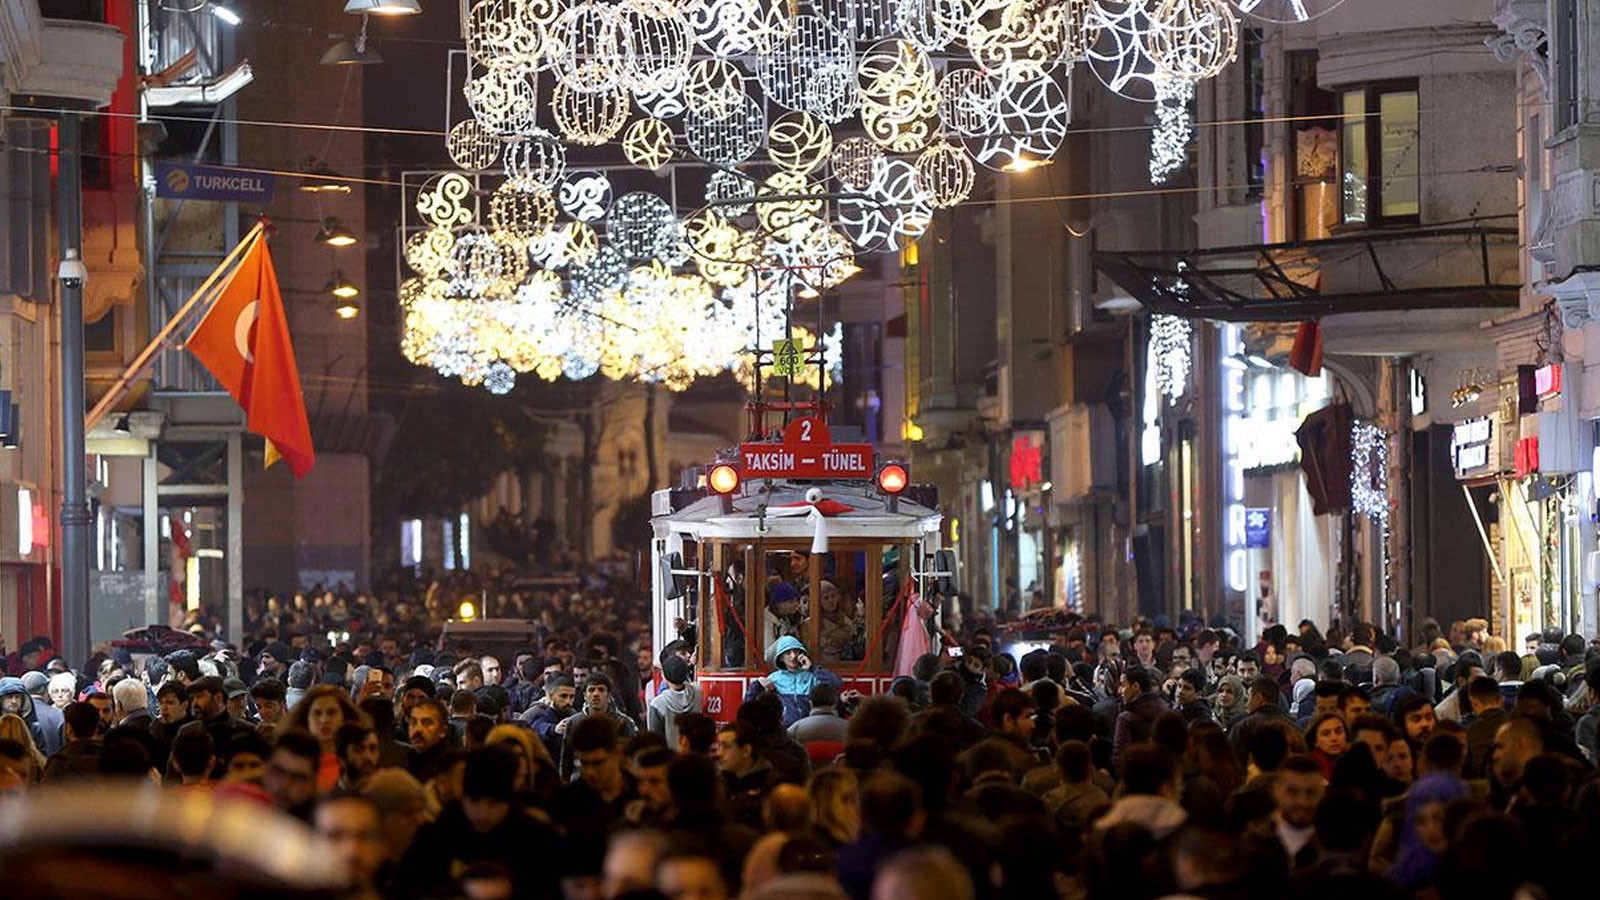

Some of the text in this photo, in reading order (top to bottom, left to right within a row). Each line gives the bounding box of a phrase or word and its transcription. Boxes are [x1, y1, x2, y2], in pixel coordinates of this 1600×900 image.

[194, 175, 265, 192] TURKCELL
[780, 355, 799, 366] 600
[778, 366, 801, 374] VOT
[801, 420, 812, 442] 2
[745, 449, 795, 471] TAKSİM
[822, 449, 866, 471] TÜNEL
[707, 696, 722, 713] 223
